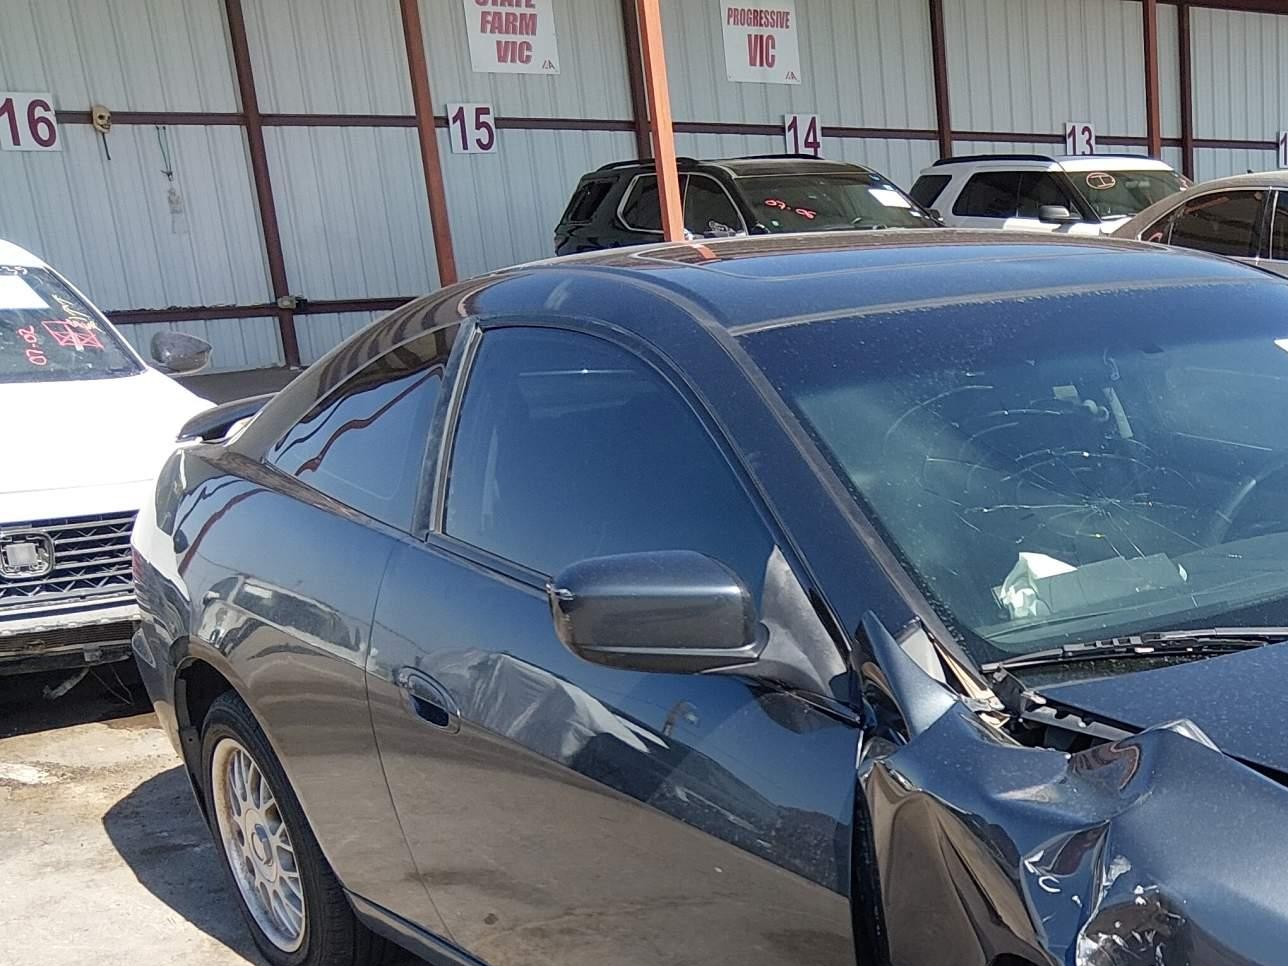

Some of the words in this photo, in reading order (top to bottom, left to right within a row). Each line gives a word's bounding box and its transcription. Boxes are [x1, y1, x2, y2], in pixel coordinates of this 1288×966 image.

[480, 11, 538, 36] FARM
[727, 7, 790, 29] PROGRESSIVE
[496, 40, 533, 65] VIC
[747, 34, 776, 69] VIC
[0, 98, 57, 147] 16
[452, 106, 495, 151] 15
[788, 116, 820, 156] 14
[1068, 125, 1094, 155] 13
